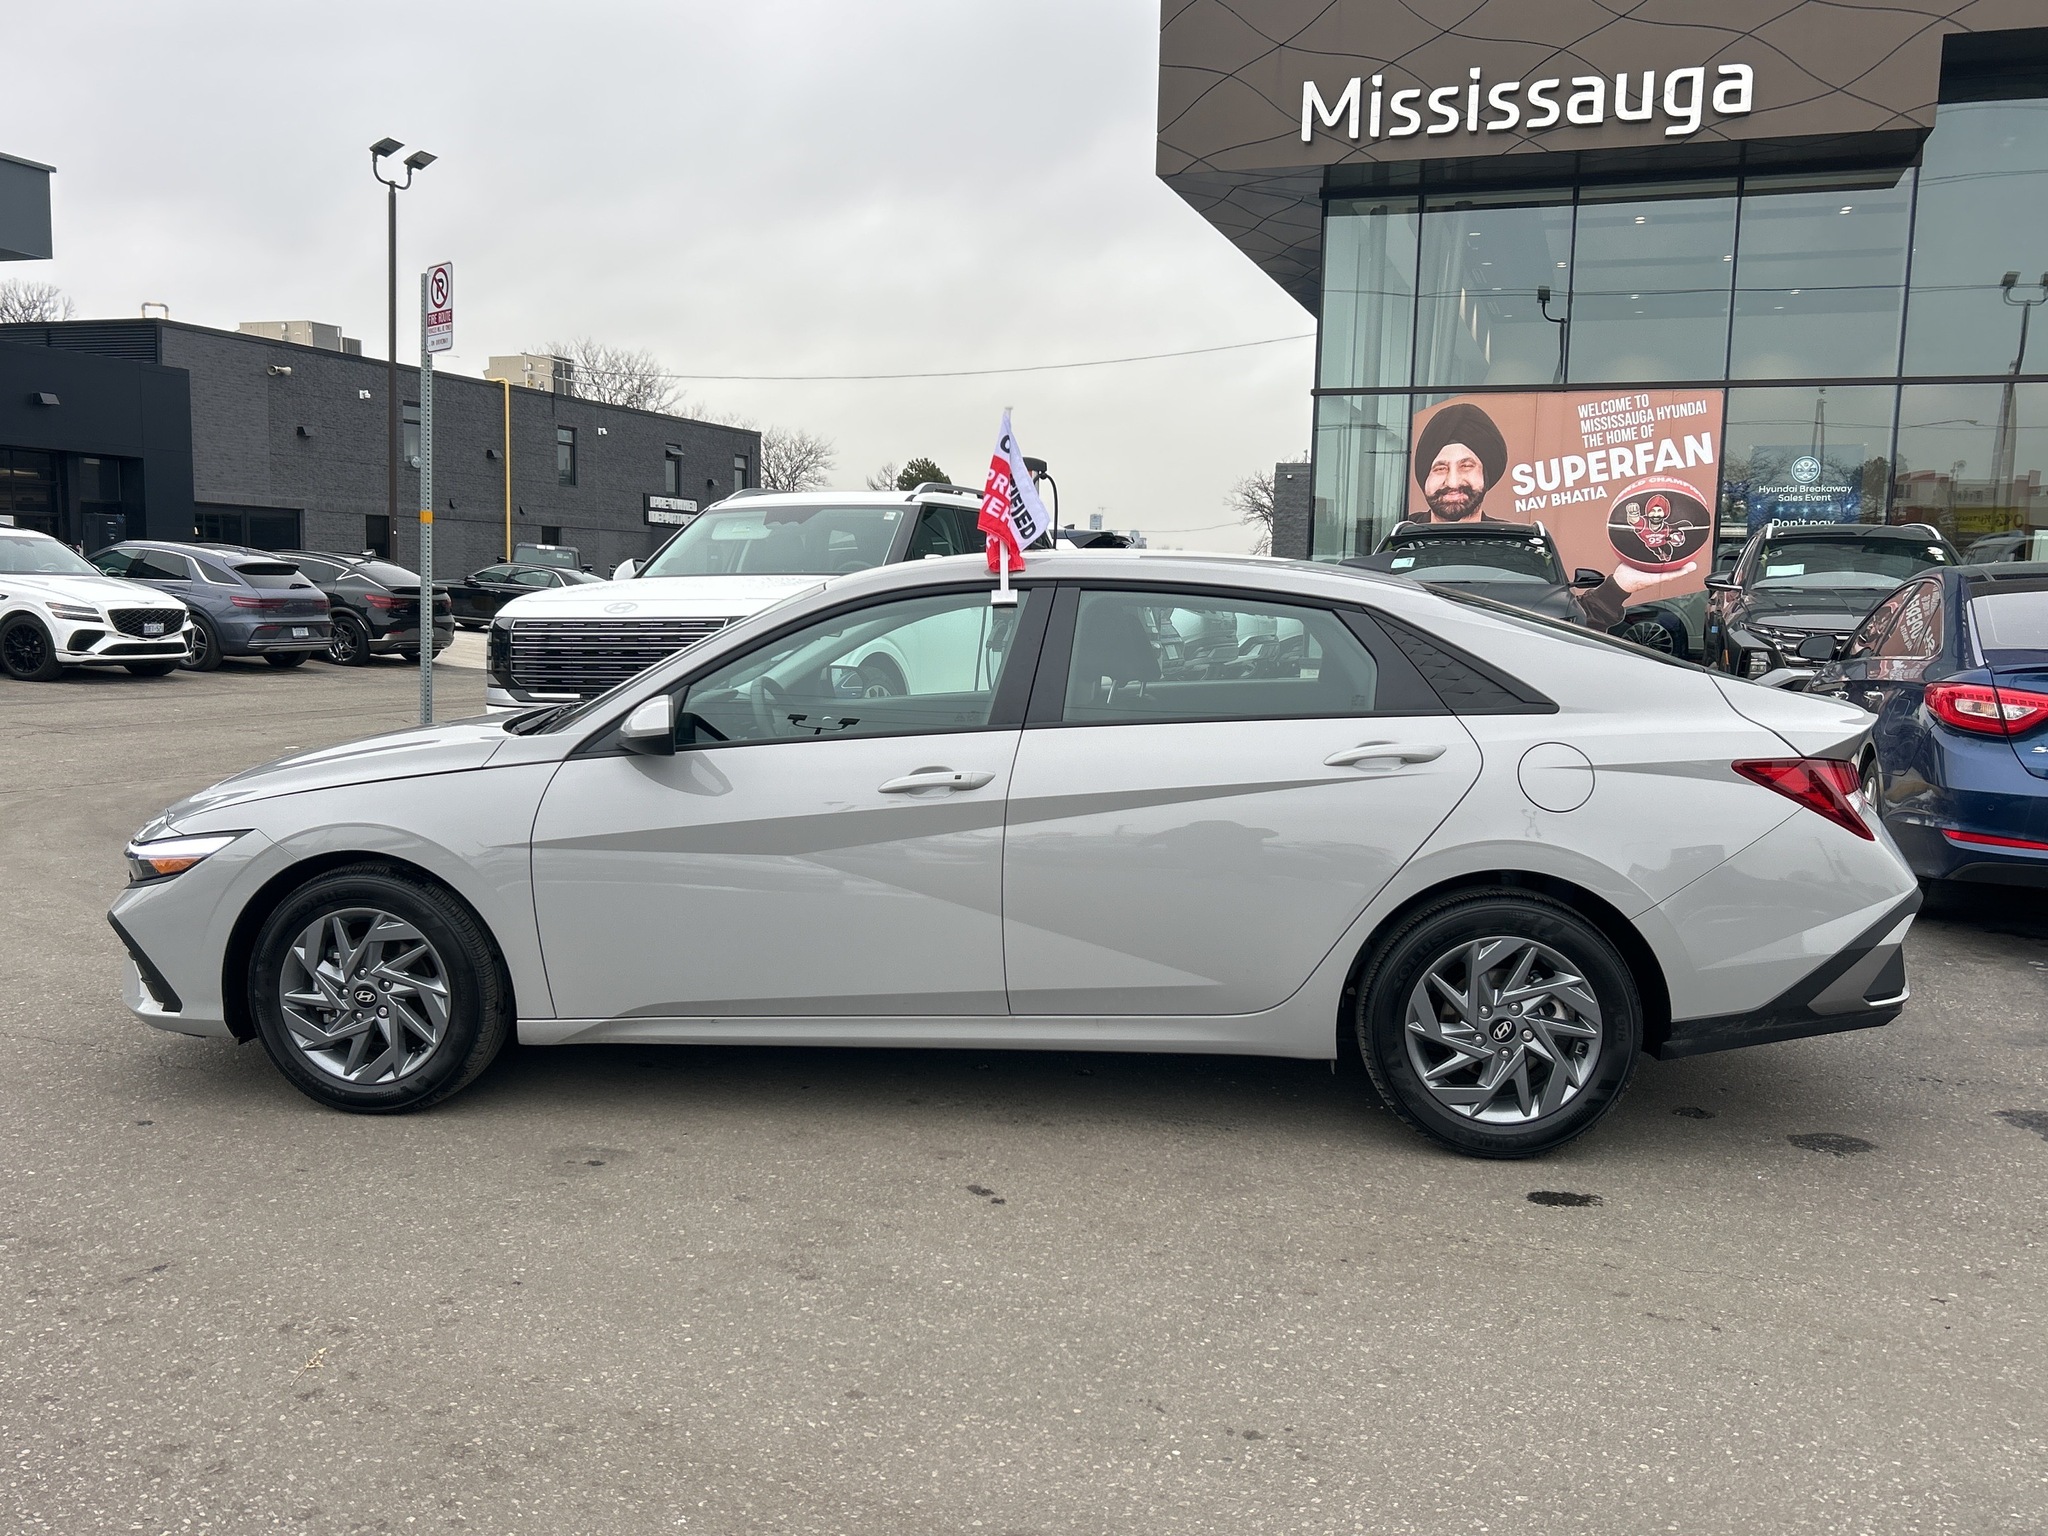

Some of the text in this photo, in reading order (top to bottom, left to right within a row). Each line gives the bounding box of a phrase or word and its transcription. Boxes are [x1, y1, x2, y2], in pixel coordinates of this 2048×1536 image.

[1301, 63, 1754, 142] Mississauga
[428, 310, 452, 326] FIRE ROUTE
[1577, 393, 1649, 418] WELCOME TO
[1580, 399, 1707, 433] MISSISSAUGA HYUNDAI
[1582, 423, 1655, 449] THE HOME OF
[1511, 432, 1714, 496] SUPERFAN
[1514, 485, 1608, 513] NAV BHATIA
[1758, 484, 1853, 495] Hyundai Breakaway
[1778, 494, 1832, 502] Sales Event
[1771, 518, 1807, 528] Don't
[1648, 537, 1662, 545] 95
